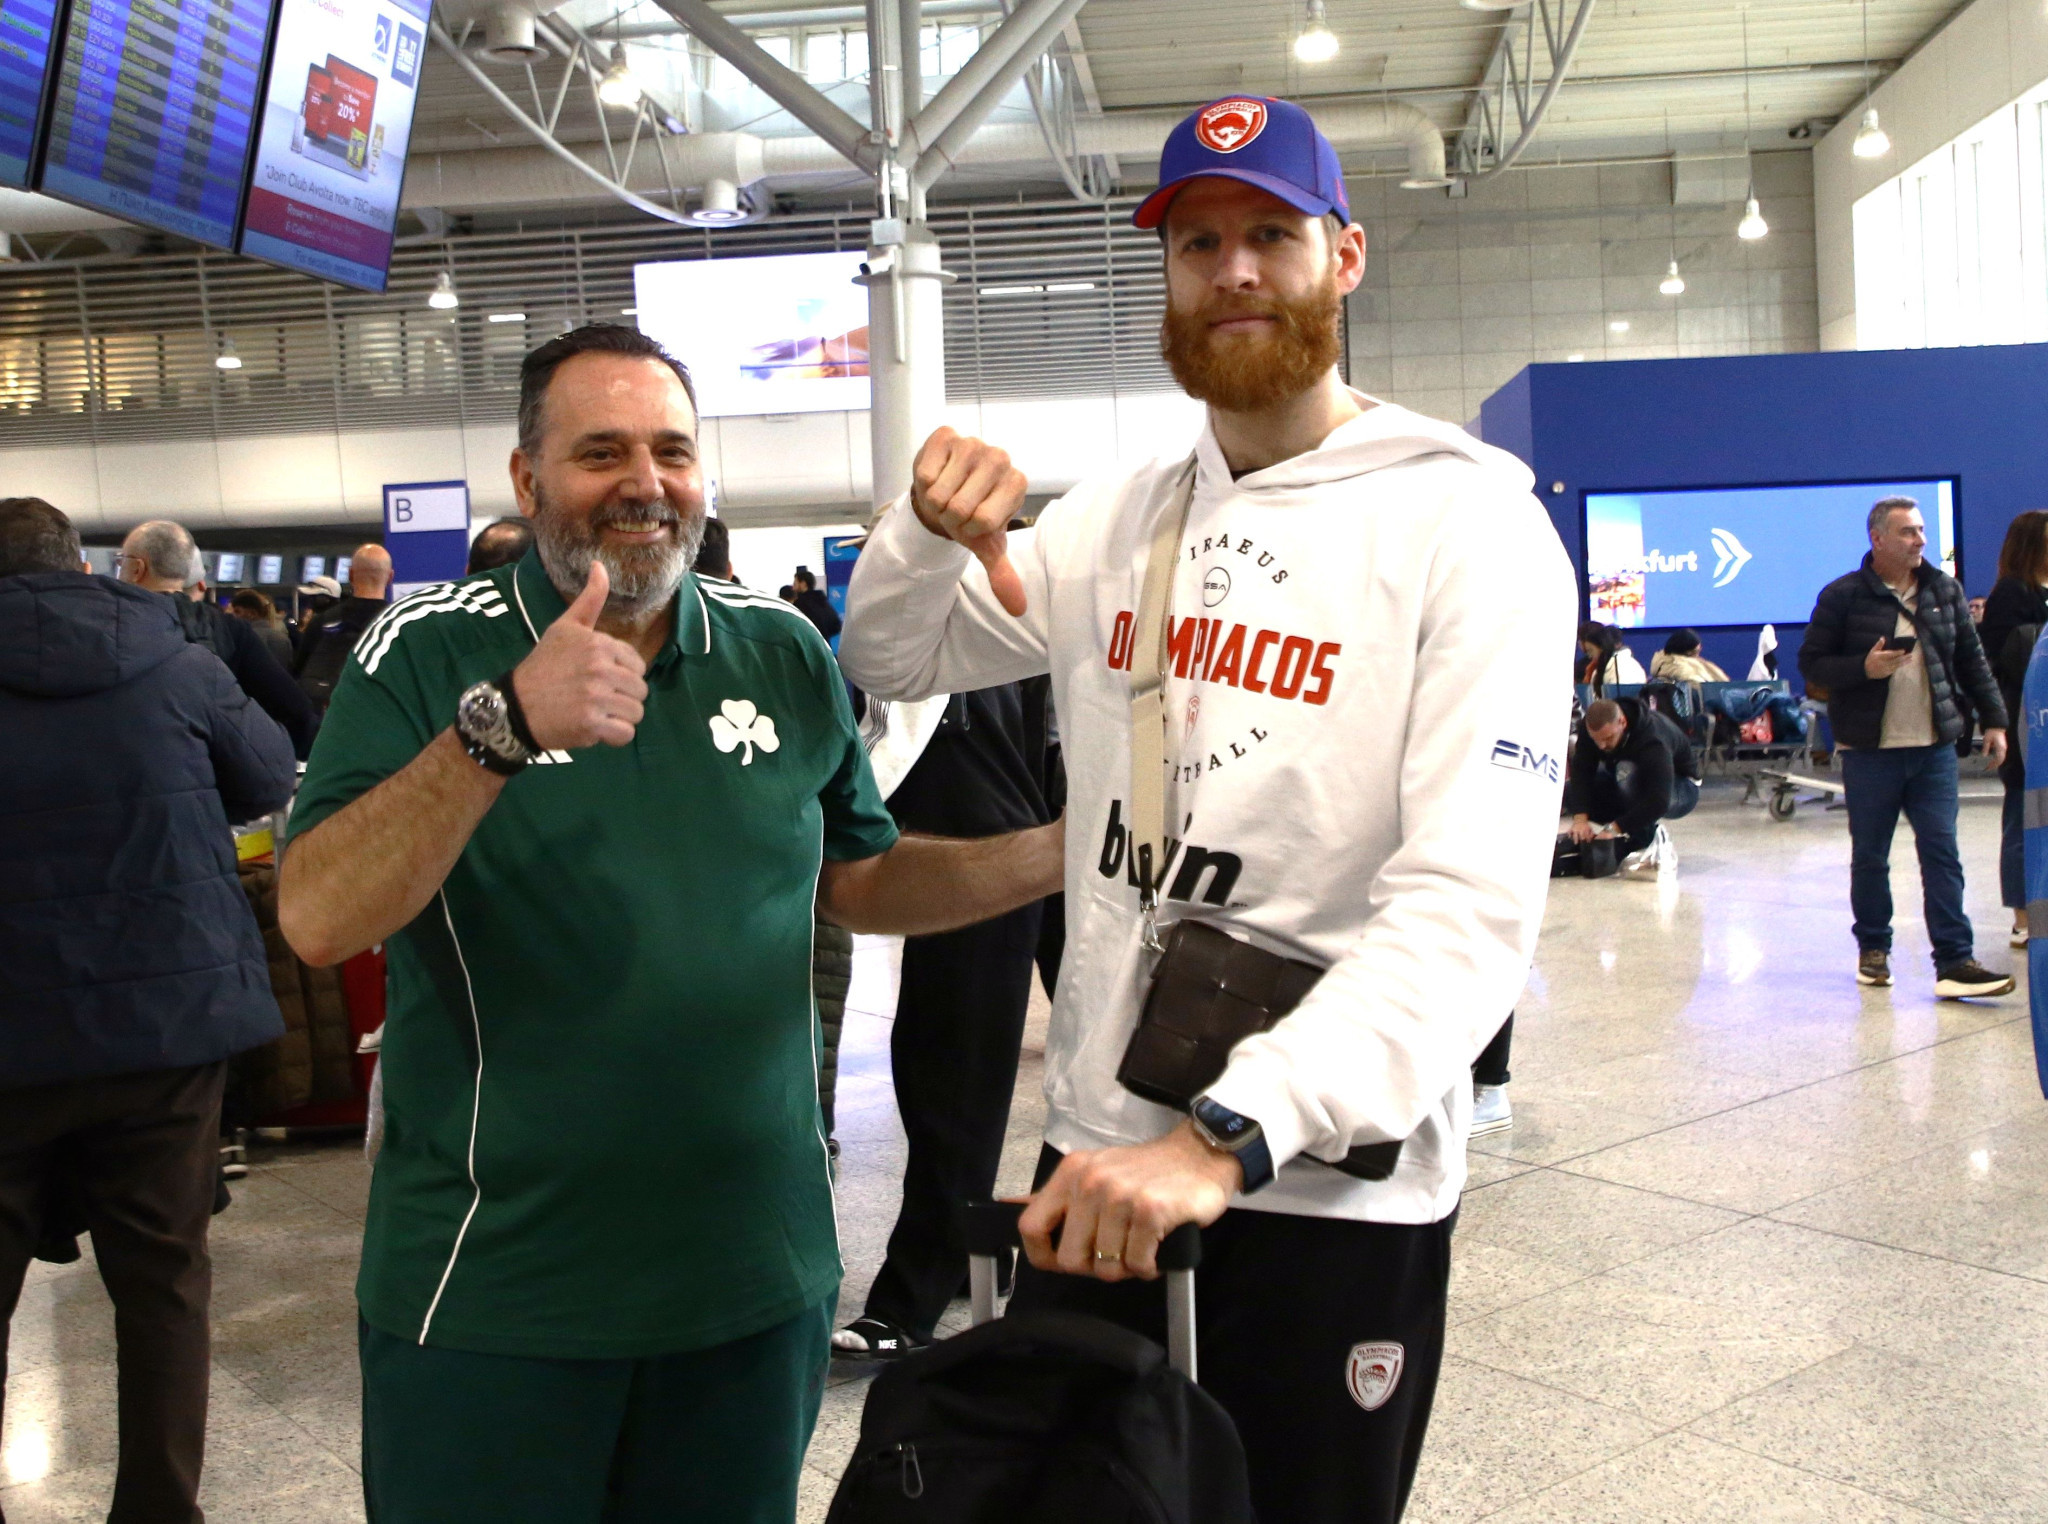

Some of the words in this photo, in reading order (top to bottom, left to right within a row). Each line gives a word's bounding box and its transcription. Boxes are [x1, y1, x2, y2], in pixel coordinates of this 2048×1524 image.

[1205, 102, 1258, 117] OLYMPIACOS
[288, 172, 307, 192] Club
[396, 498, 413, 523] B
[1176, 533, 1289, 585] IRAEUS
[1107, 610, 1343, 706] OMPIACOS
[878, 1339, 898, 1350] NIKE
[1357, 1347, 1400, 1357] OLYMPIACOS
